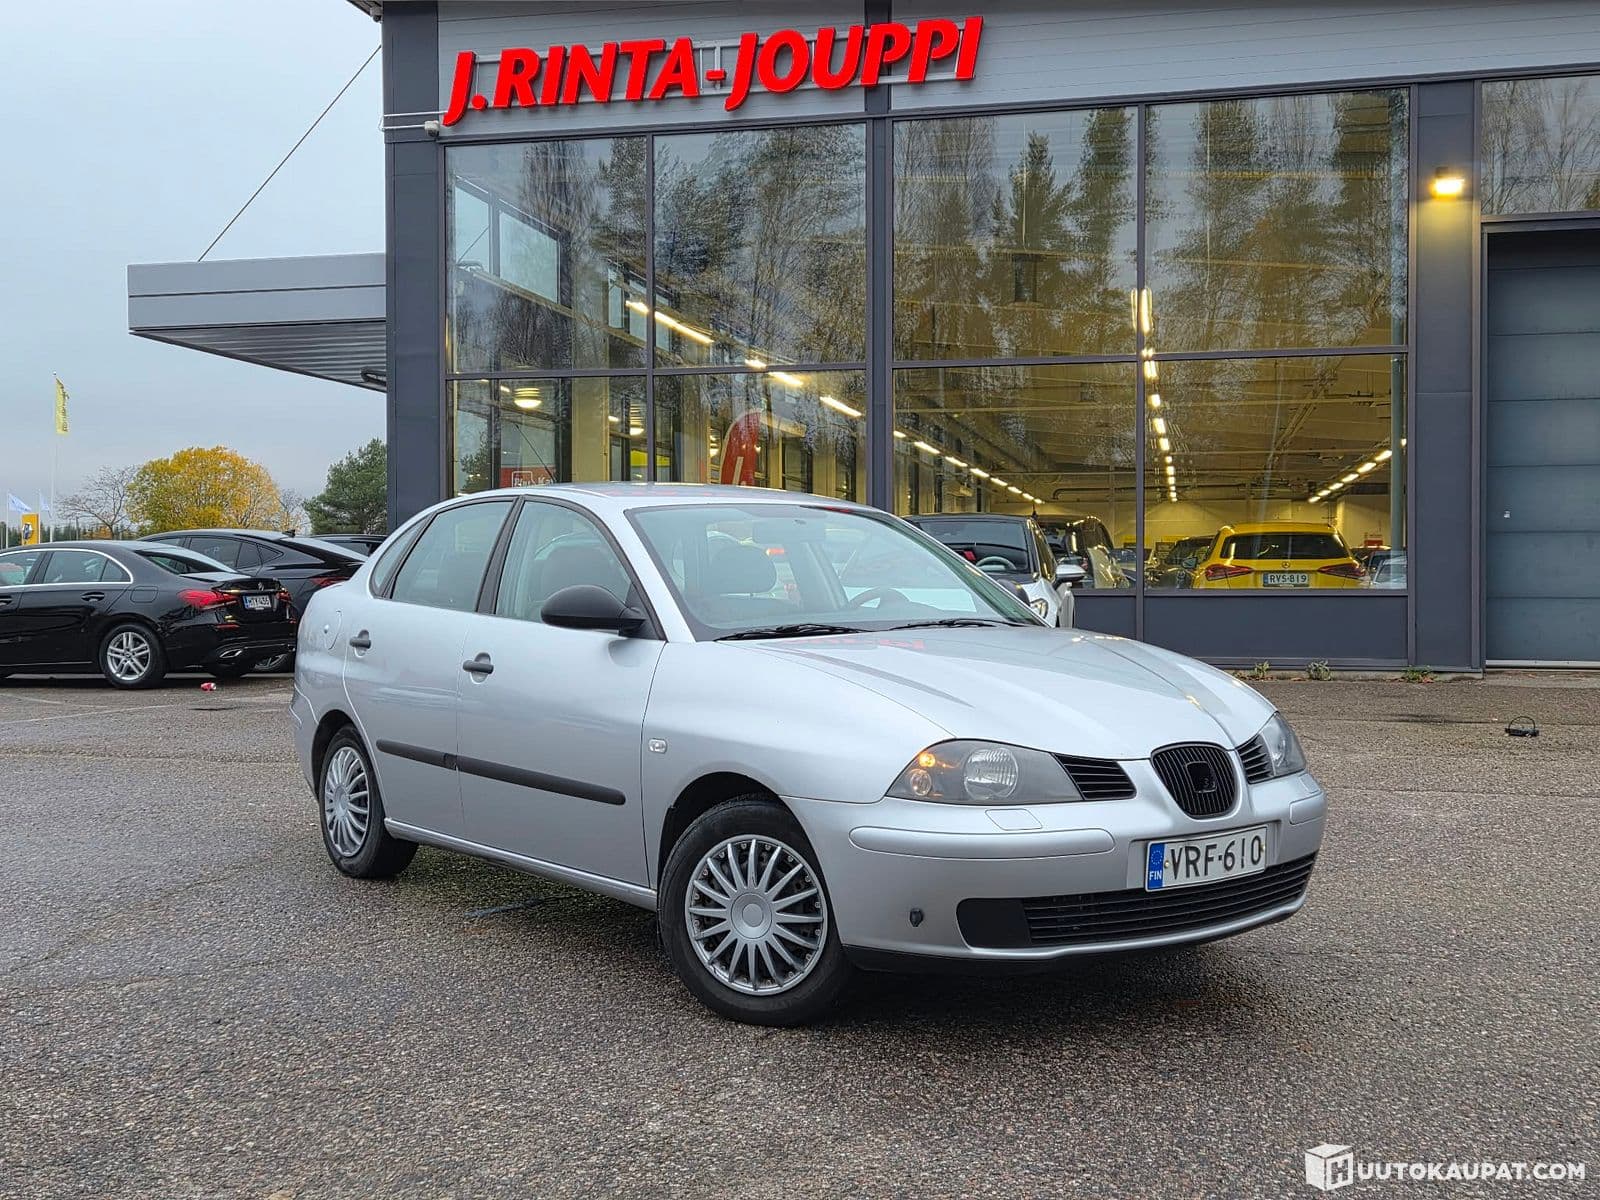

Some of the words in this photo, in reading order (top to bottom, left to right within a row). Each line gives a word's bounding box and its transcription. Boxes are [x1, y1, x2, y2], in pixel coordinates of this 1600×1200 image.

[1269, 573, 1307, 584] RVS-819
[1170, 834, 1262, 880] VRF-610
[1149, 870, 1163, 882] FIN
